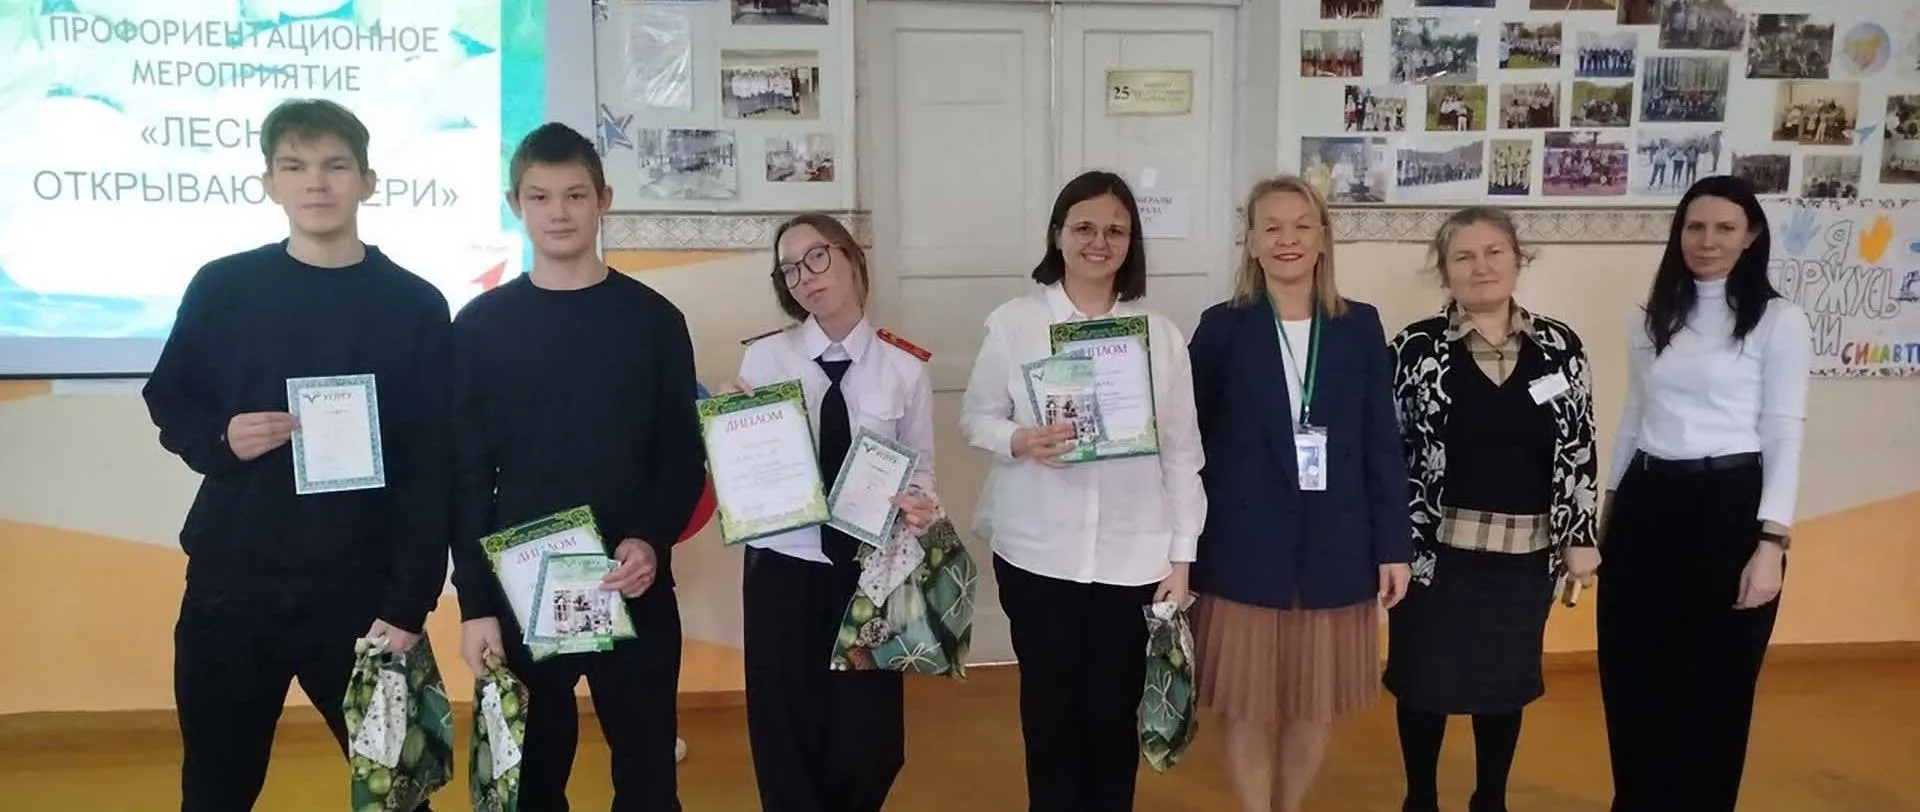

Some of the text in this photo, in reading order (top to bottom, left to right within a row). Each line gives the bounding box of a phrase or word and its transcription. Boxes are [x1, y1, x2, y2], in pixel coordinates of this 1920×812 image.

[49, 15, 440, 56] ПРОФОРИЕНТАЦИОННОЕ
[131, 59, 361, 91] МЕРОПРИЯТИЕ
[1113, 86, 1130, 100] 25
[141, 116, 263, 149] «ЛЕСН
[33, 169, 459, 208] ОТКРЫВАЮ ЕРИ»
[726, 410, 784, 433] ДИПЛОМ
[516, 536, 577, 565] ДИЛОМ
